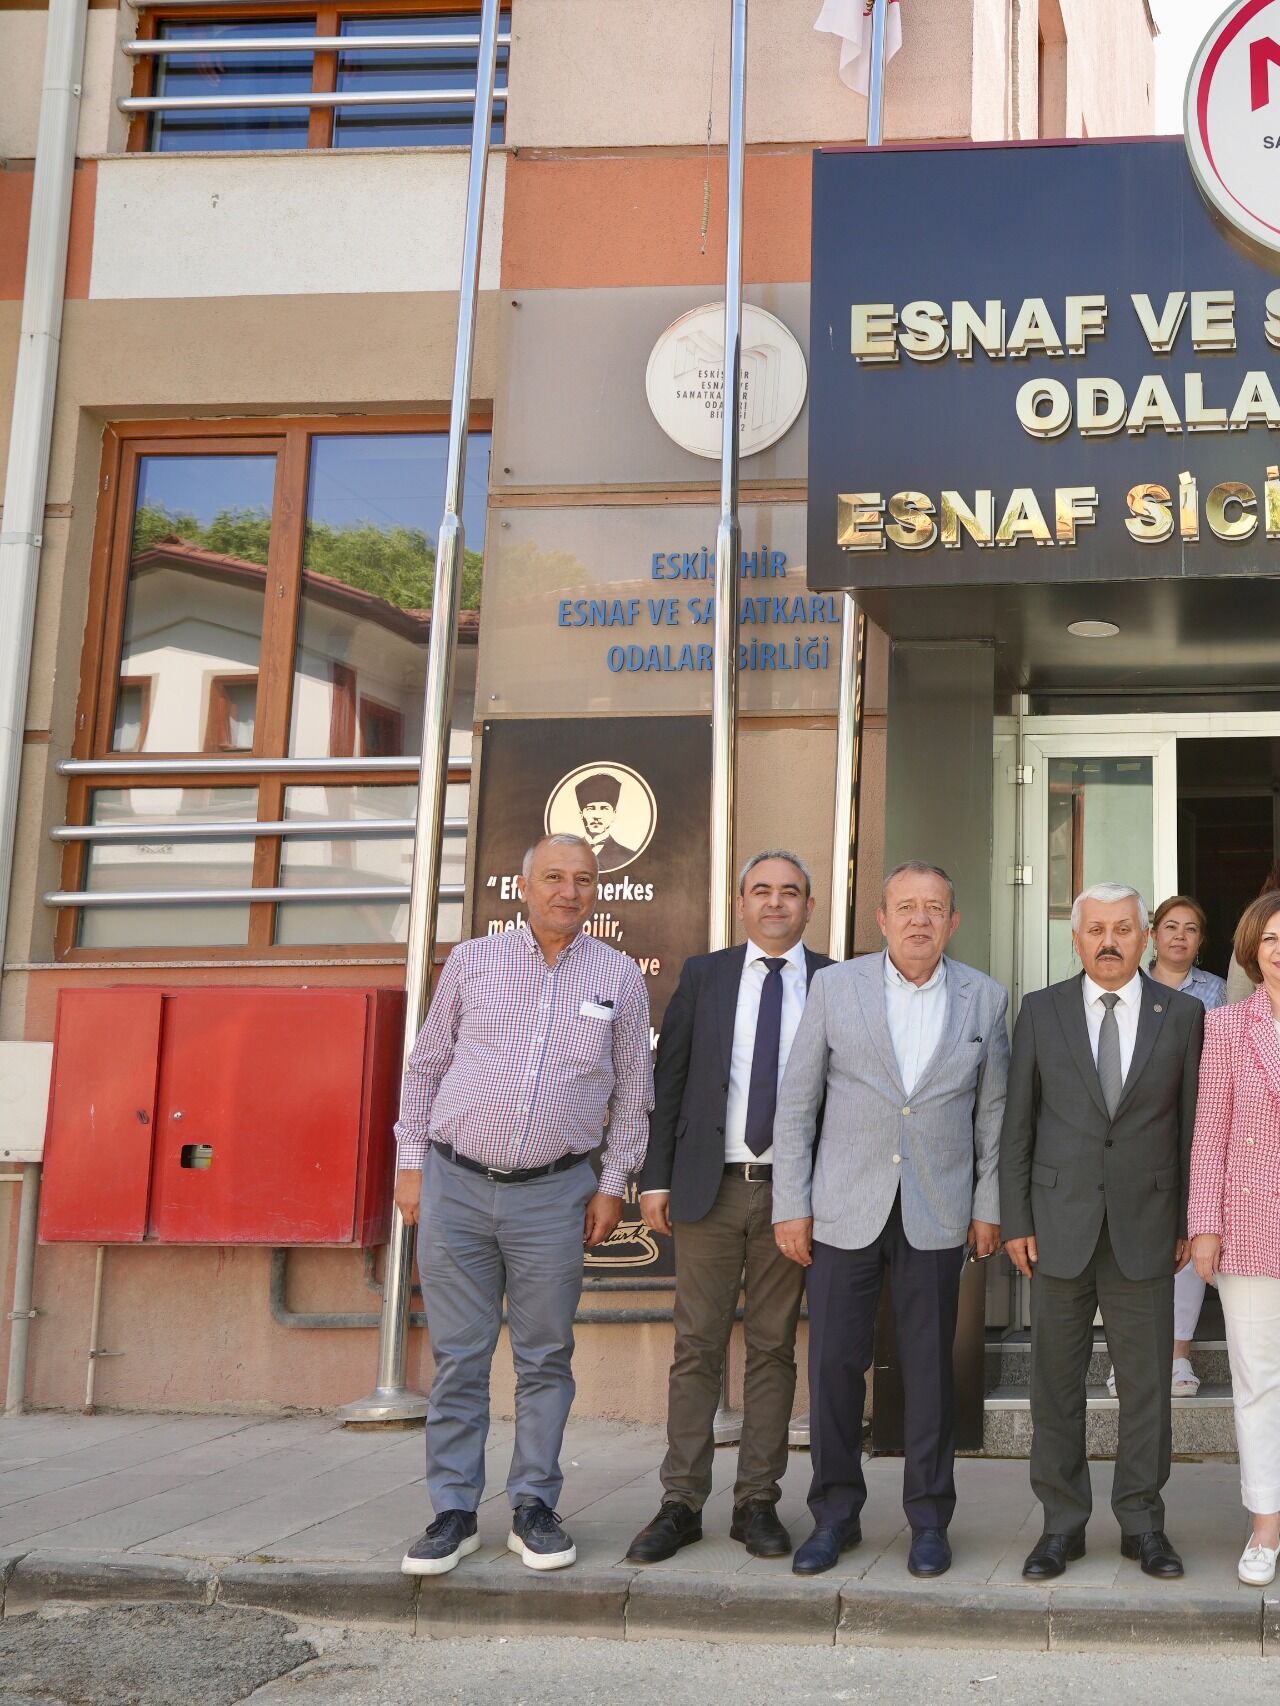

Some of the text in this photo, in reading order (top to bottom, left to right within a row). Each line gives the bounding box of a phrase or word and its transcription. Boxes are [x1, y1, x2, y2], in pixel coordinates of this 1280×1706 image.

[850, 295, 1107, 361] ESNAF
[1131, 290, 1237, 351] VE
[837, 486, 1099, 550] ESNAF
[558, 599, 640, 626] ESNAF
[648, 598, 679, 625] VE
[607, 644, 713, 672] ODALAR
